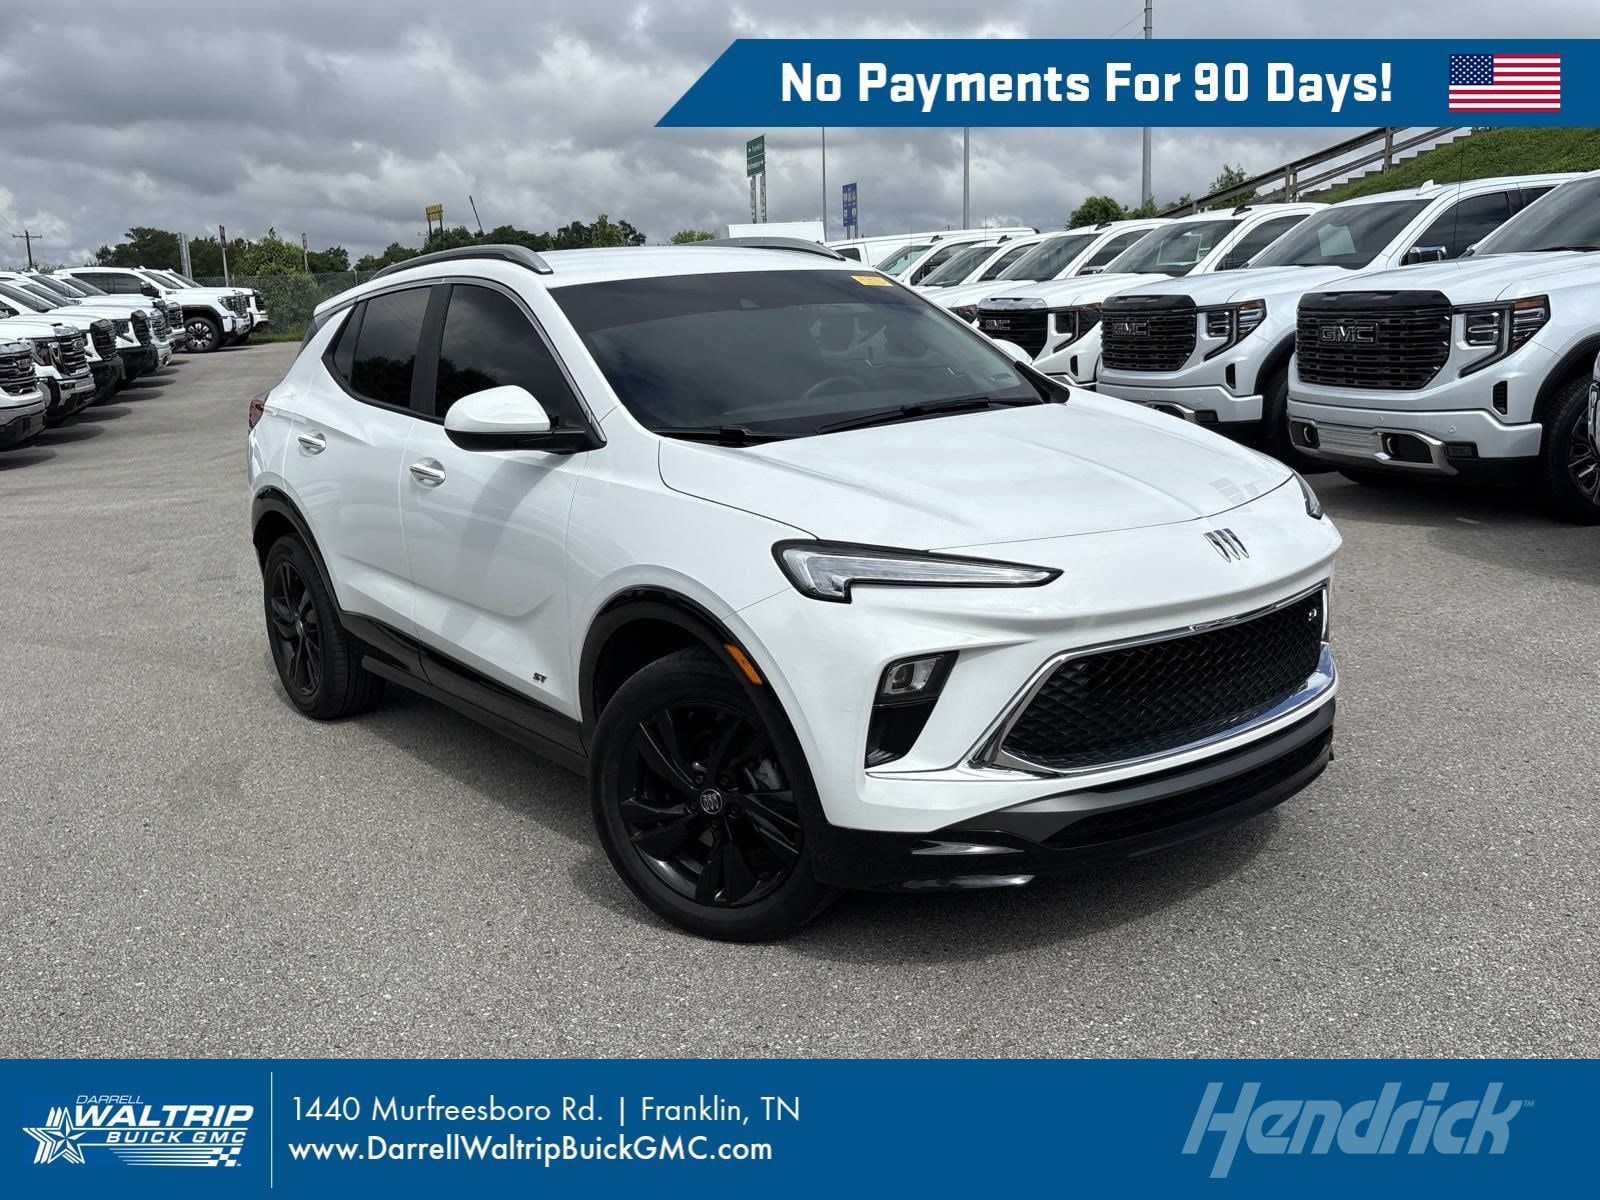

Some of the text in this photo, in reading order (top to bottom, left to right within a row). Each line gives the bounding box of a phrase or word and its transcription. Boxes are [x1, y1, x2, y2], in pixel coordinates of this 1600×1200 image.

[1112, 322, 1147, 336] GMC
[1320, 325, 1375, 343] GMC
[532, 672, 547, 683] ST
